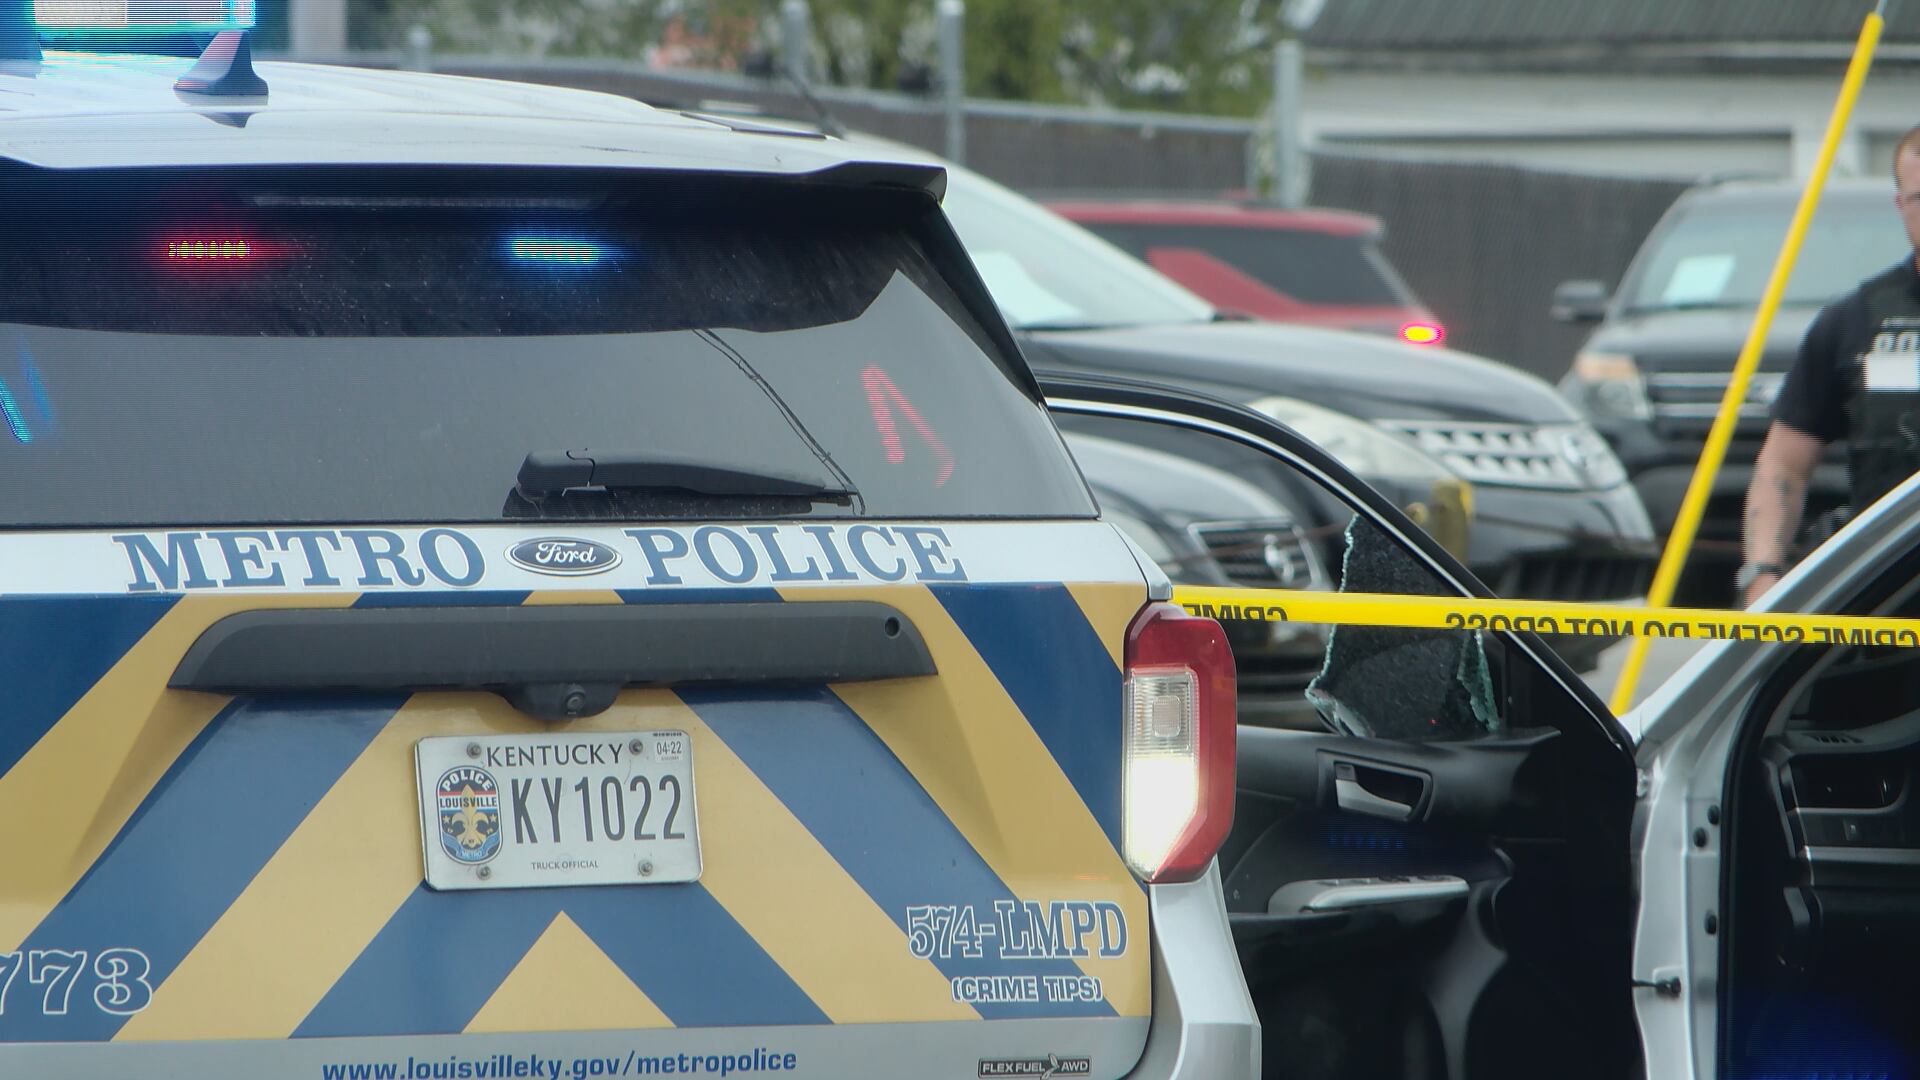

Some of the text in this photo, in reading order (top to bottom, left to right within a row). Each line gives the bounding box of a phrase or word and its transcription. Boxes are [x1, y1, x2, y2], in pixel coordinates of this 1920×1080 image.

[111, 524, 969, 593] METRO POLICE
[535, 541, 598, 565] Ford
[487, 743, 623, 768] KENTUCKY
[441, 769, 493, 792] POLICE
[439, 796, 498, 809] LOUISVILLE
[511, 774, 686, 845] KY1022
[531, 859, 599, 871] TRUCK OFFICIAL
[906, 900, 1129, 959] 574-LMPD
[952, 975, 1104, 1003] (CRIME TIPS)
[322, 1047, 798, 1080] www.louisvilleky.gov/metropolice
[982, 1060, 1089, 1074] FLEX FUEL AWD
